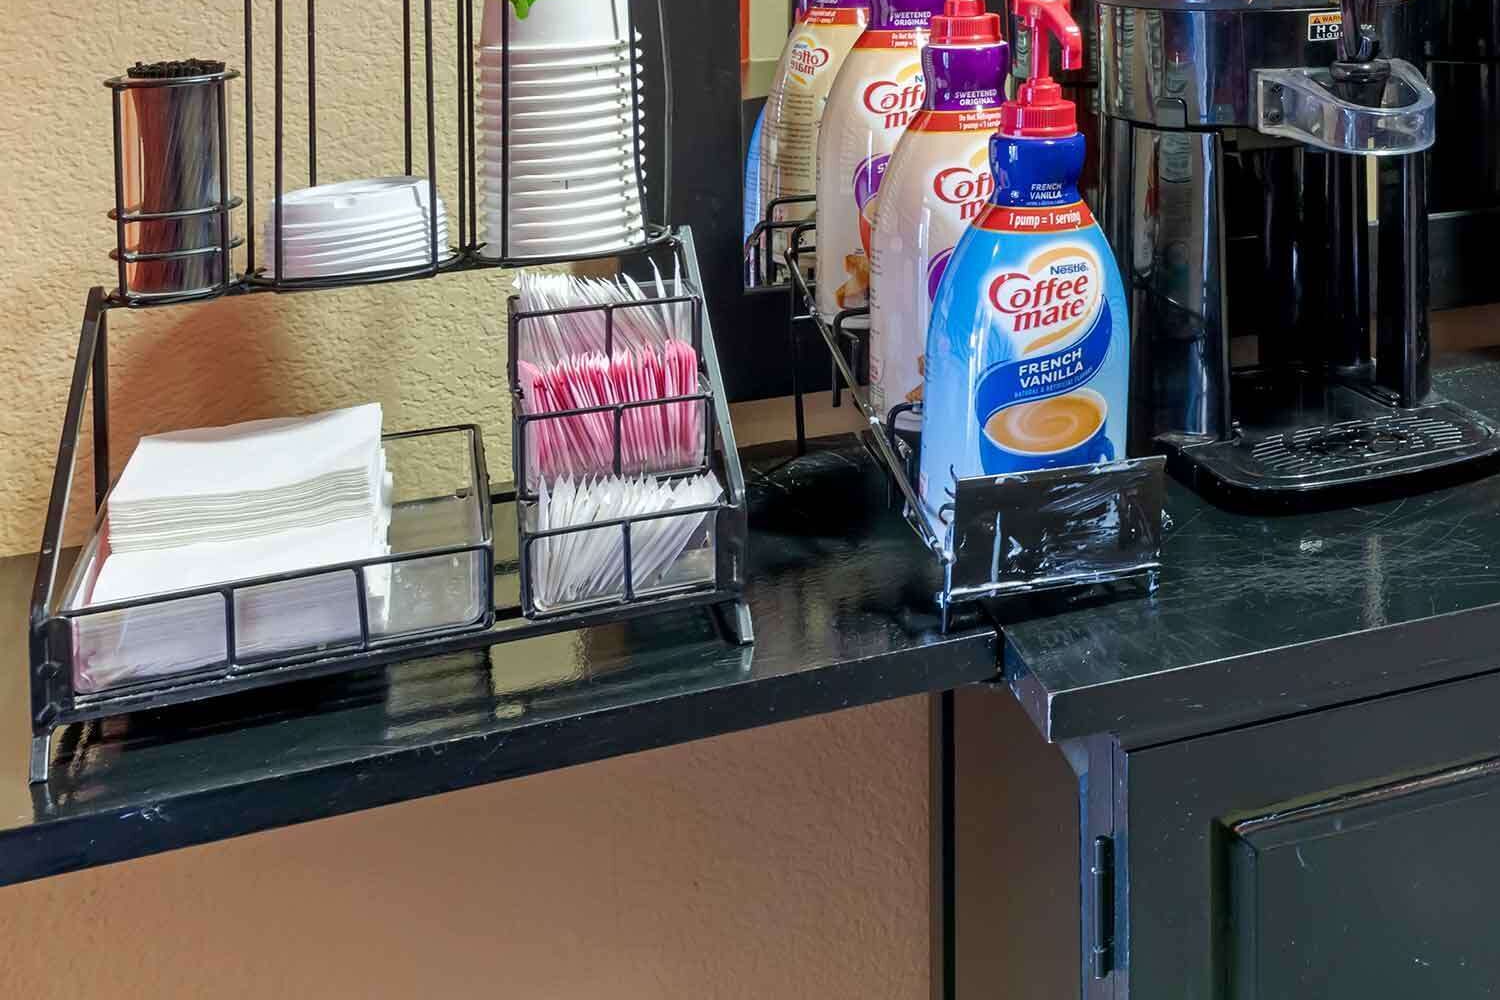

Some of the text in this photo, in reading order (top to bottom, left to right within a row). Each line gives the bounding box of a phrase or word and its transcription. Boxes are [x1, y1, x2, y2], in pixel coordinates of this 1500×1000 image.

[1317, 25, 1339, 33] HO
[955, 89, 997, 98] SWEETENED
[960, 98, 995, 106] ORIGINAL
[1031, 183, 1062, 191] FRENCH
[1030, 190, 1062, 199] VANILLA
[1009, 213, 1014, 225] 1
[1014, 215, 1040, 229] pump
[1049, 212, 1053, 224] 1
[1056, 210, 1081, 225] serving
[988, 273, 1088, 314] Coffee
[1013, 298, 1085, 332] mate
[1019, 348, 1082, 376] FRENCH
[1020, 362, 1084, 388] VANILLA
